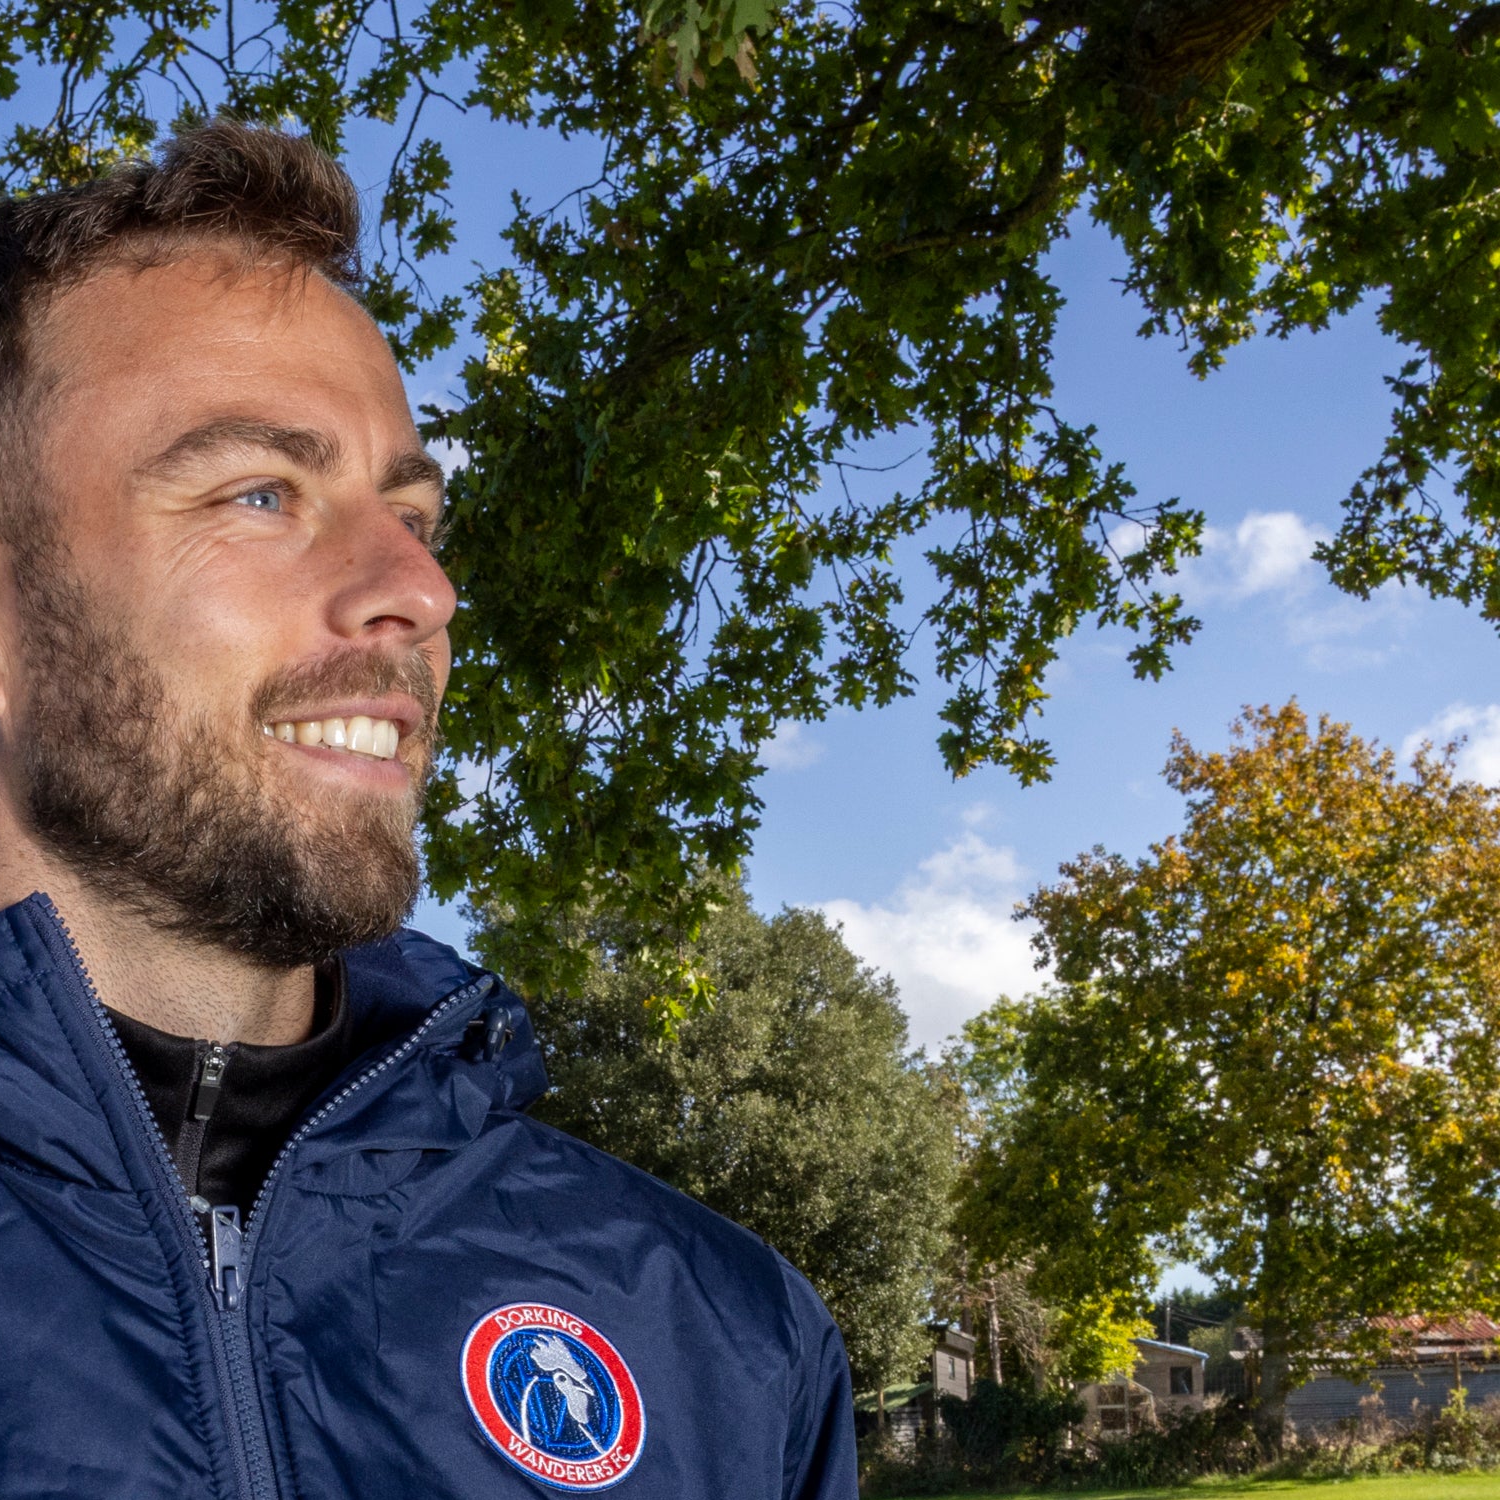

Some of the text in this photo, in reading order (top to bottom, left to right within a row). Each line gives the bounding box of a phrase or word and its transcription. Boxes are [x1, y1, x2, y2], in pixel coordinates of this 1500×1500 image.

[494, 1308, 583, 1336] DORKING
[508, 1435, 631, 1482] WANDERERS FC
